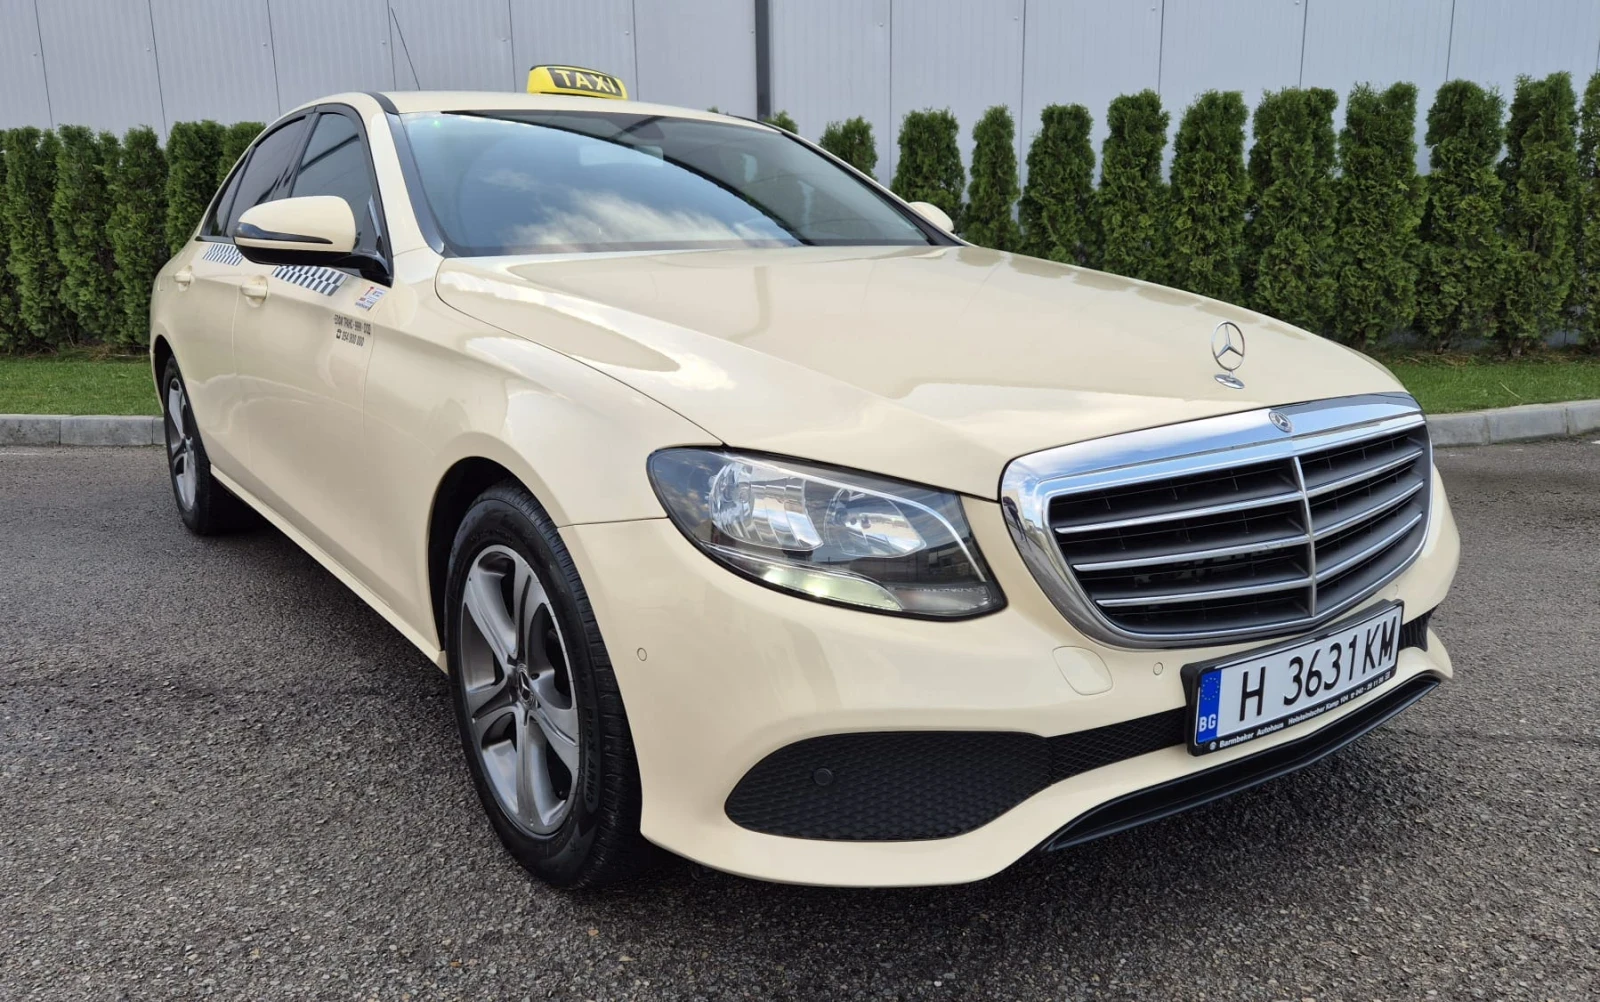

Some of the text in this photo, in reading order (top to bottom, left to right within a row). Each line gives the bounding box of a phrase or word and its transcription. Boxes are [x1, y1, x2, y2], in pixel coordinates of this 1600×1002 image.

[554, 70, 616, 93] TAXI
[1239, 666, 1267, 722] H
[1198, 713, 1217, 733] BG
[1256, 722, 1285, 737] Autohaus
